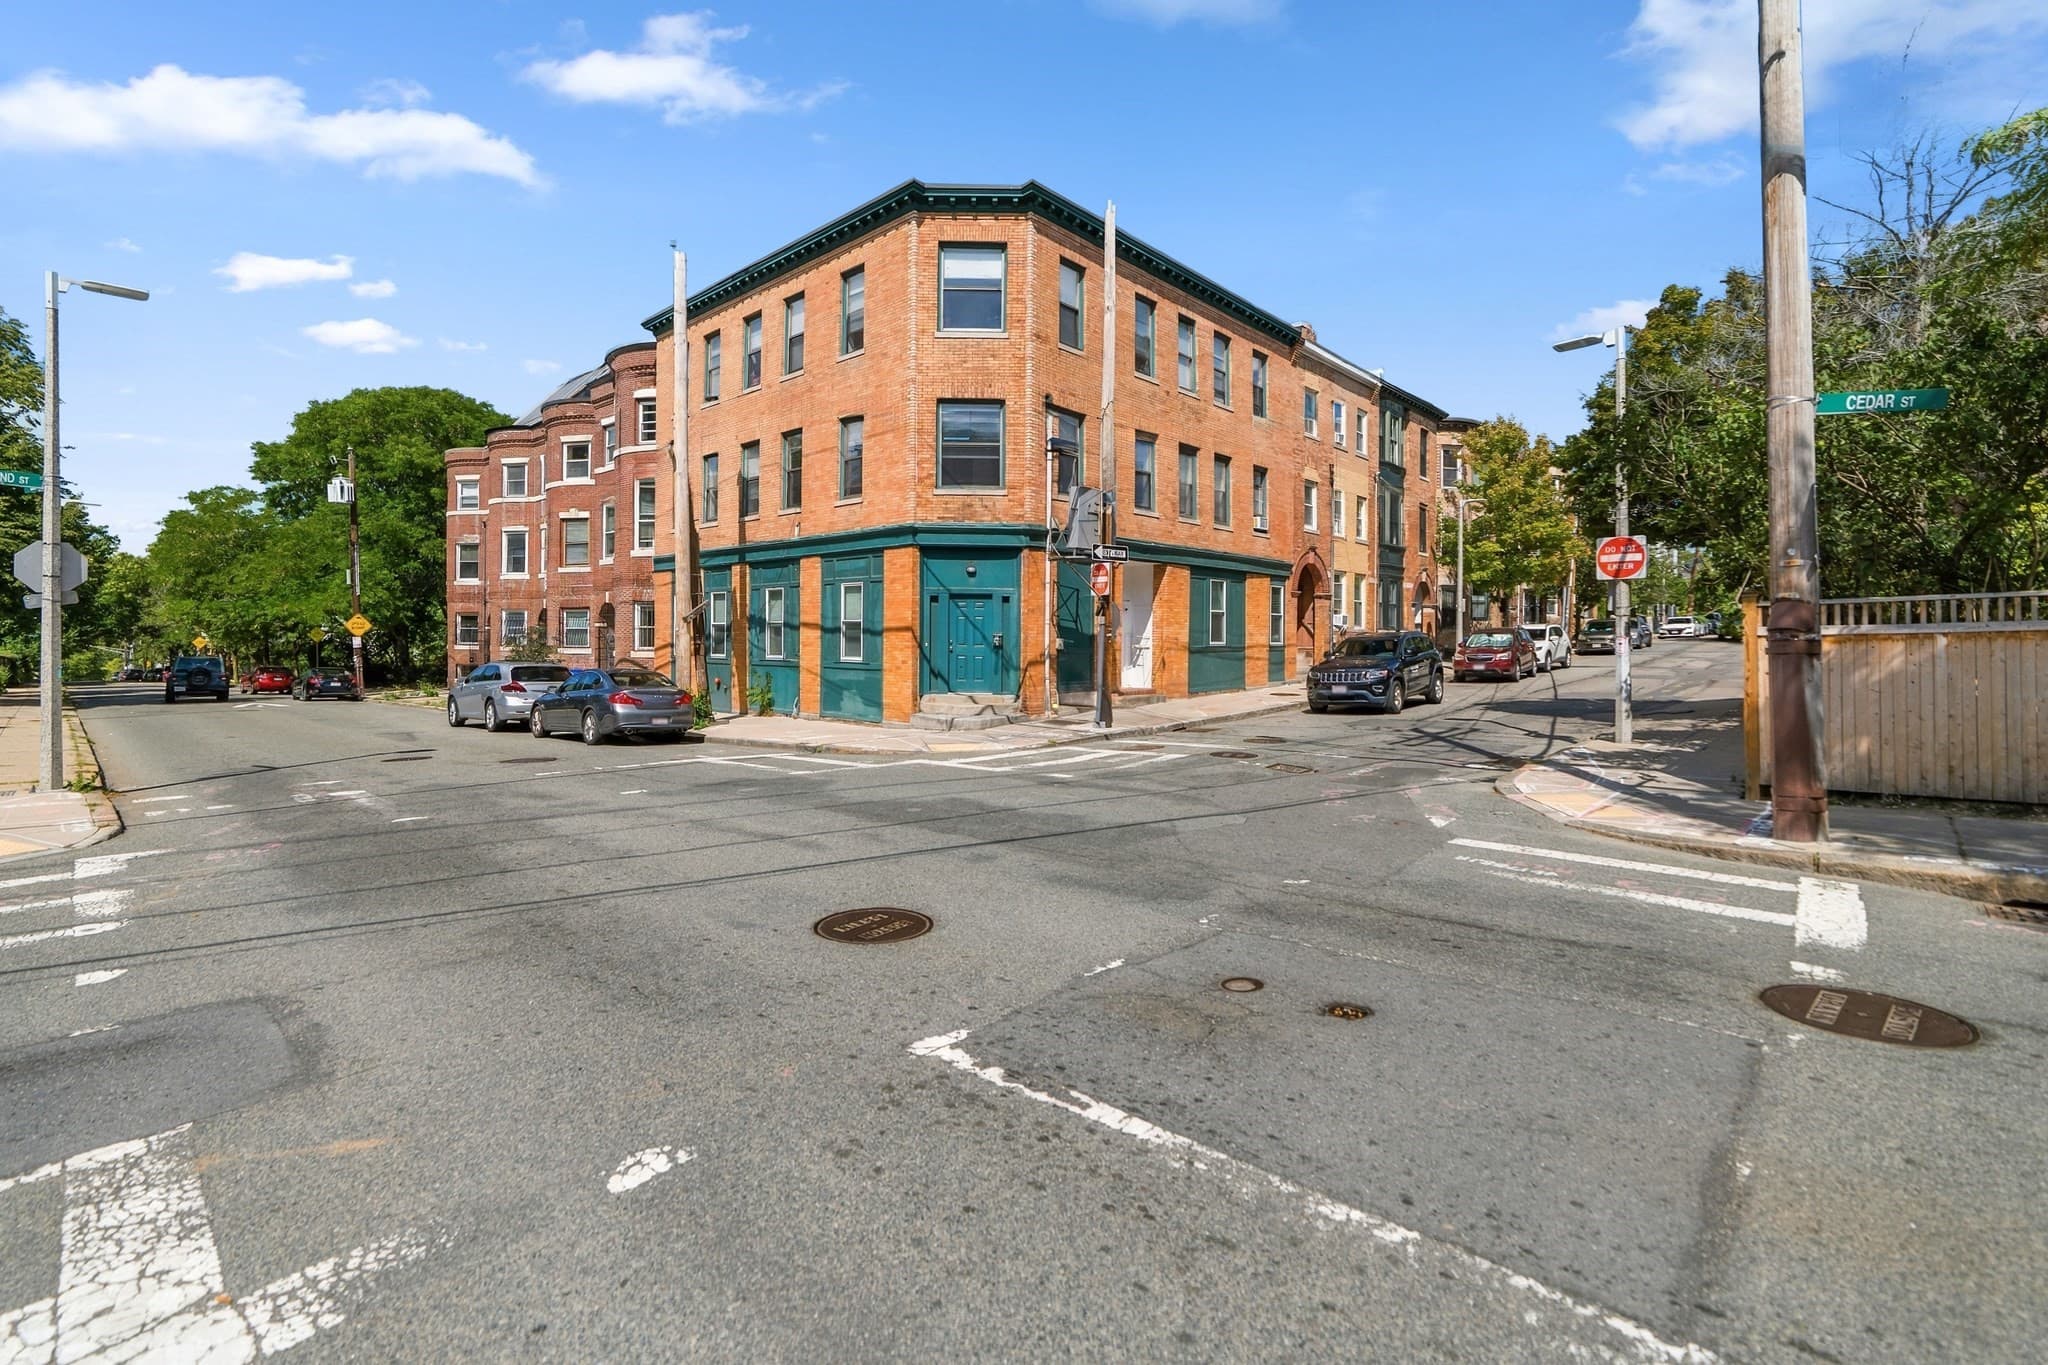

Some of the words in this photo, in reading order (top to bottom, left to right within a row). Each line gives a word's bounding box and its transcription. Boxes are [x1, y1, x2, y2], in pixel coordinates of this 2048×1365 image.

[1845, 394, 1895, 410] CEDAR
[1901, 396, 1916, 408] ST
[18, 476, 29, 485] ST
[1607, 563, 1634, 571] ENTER
